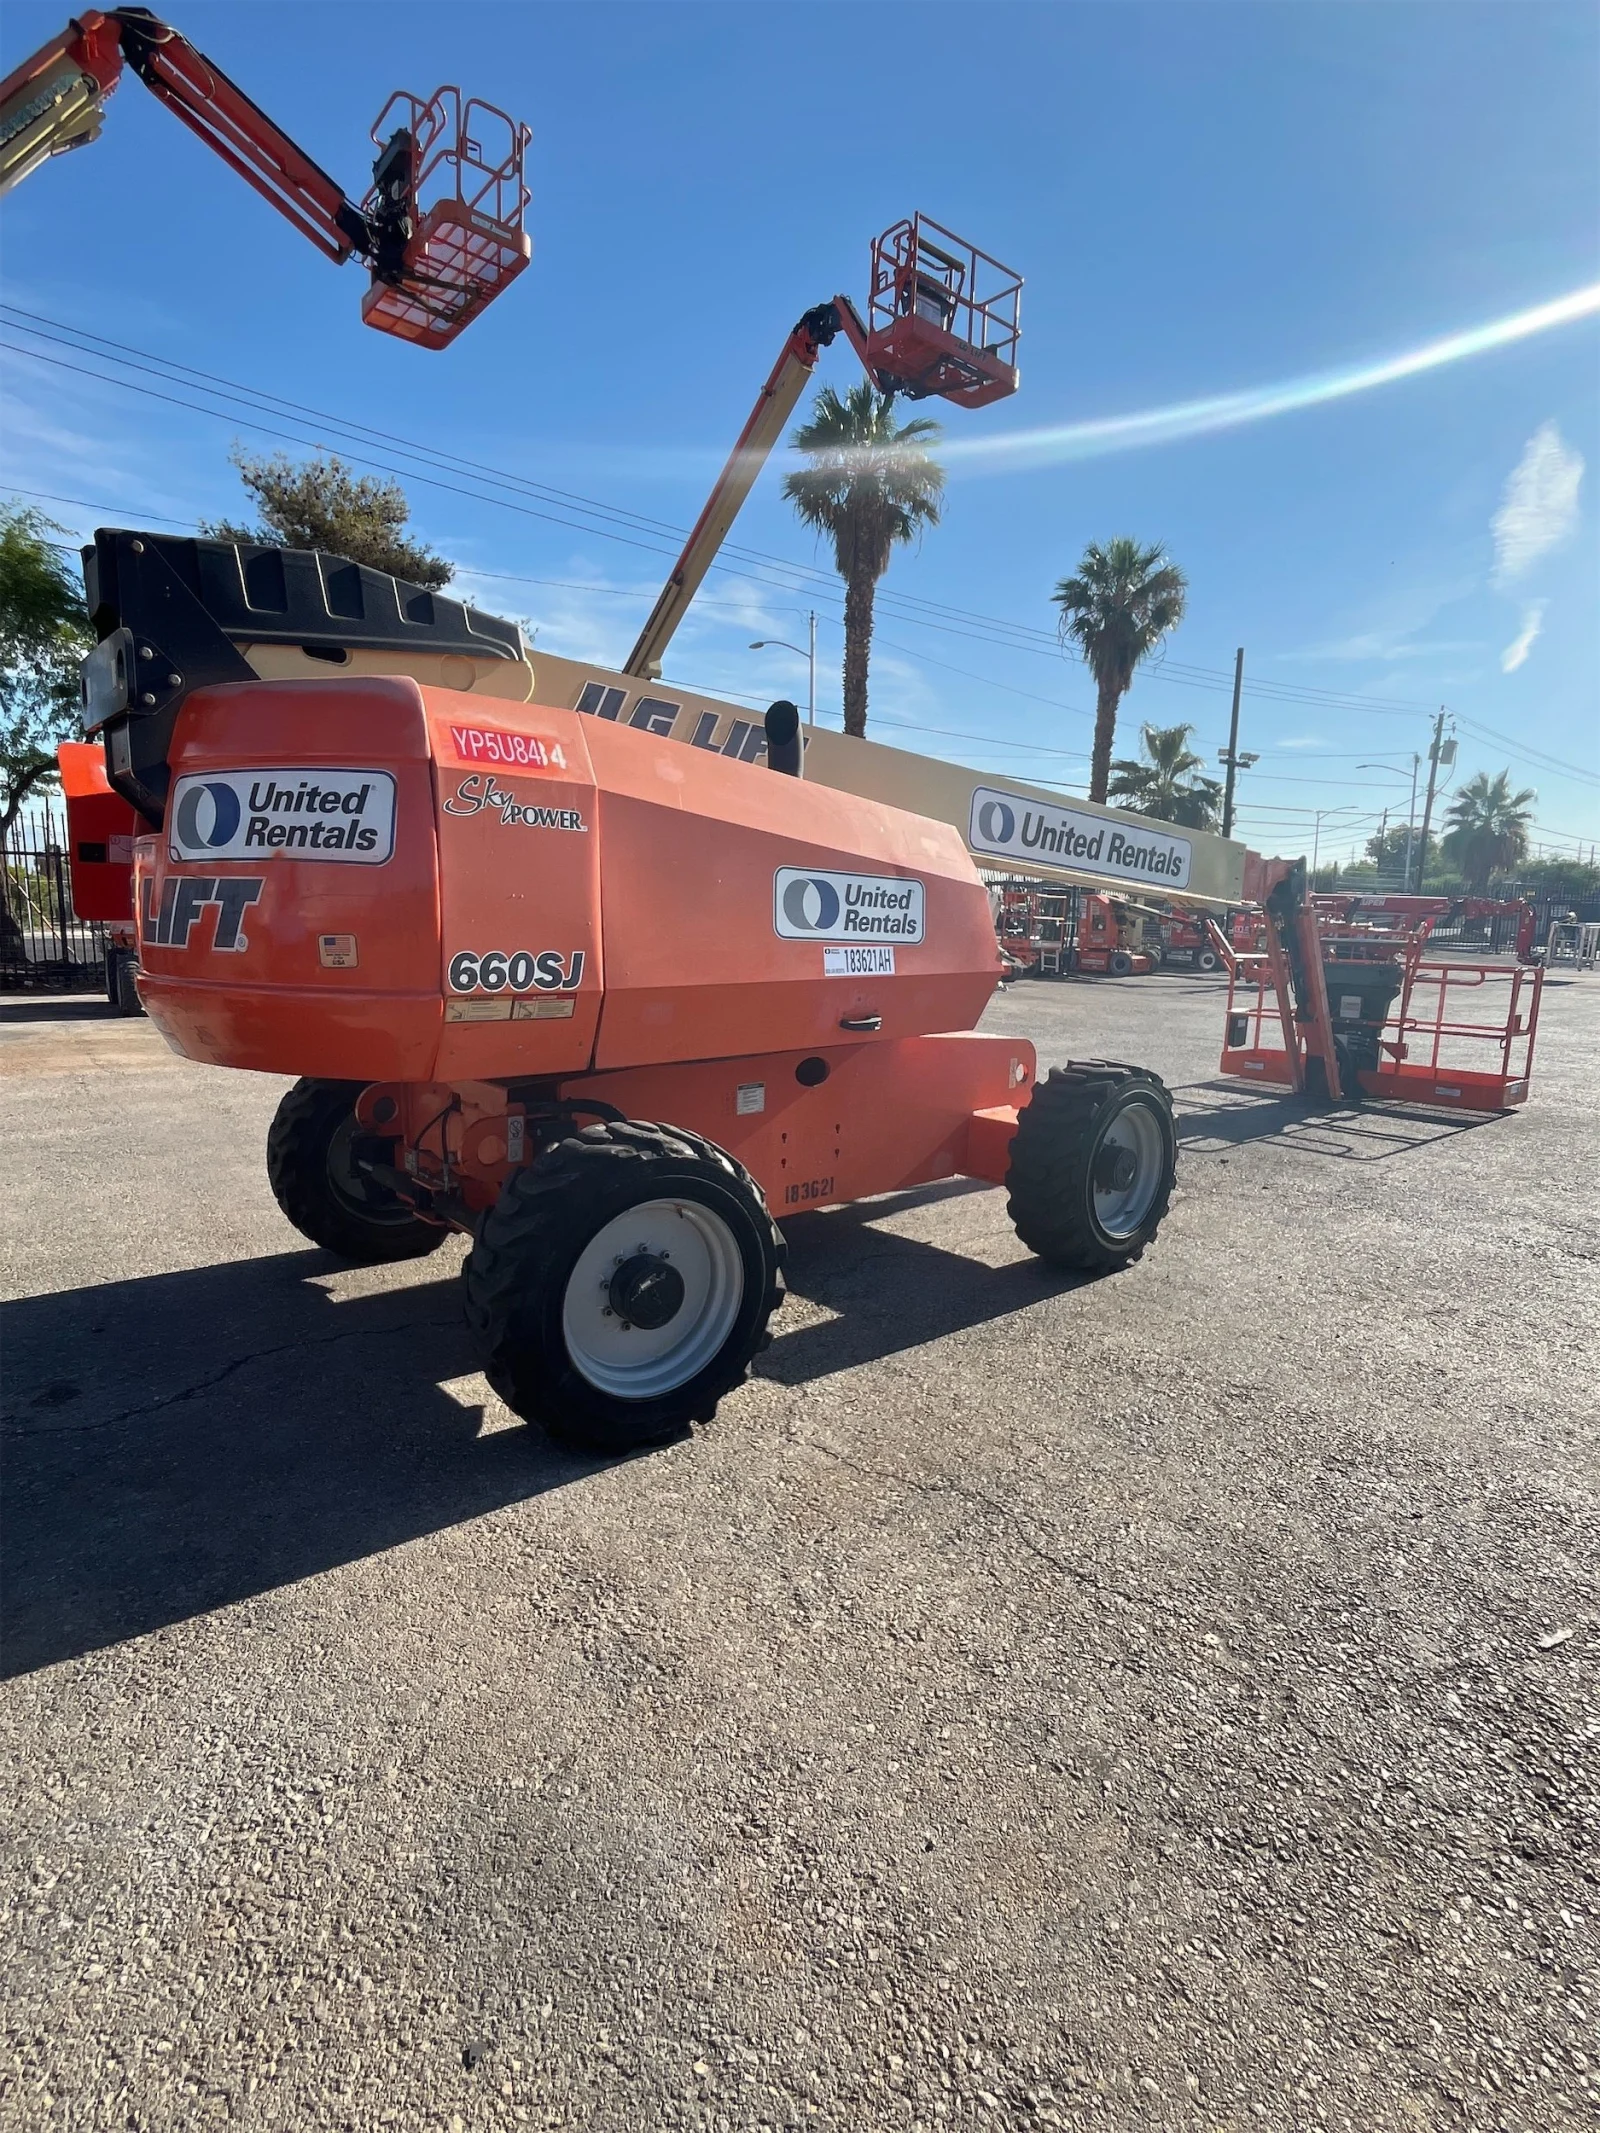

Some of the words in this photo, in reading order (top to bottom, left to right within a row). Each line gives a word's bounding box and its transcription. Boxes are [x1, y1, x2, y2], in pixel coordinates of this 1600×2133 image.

[690, 710, 812, 764] LIF
[249, 782, 370, 815] United
[245, 817, 378, 850] Rentals
[1021, 812, 1104, 861] United
[1107, 833, 1182, 877] Rentals
[845, 884, 912, 910] United
[142, 877, 267, 951] LIFT
[844, 909, 917, 934] Rentals
[448, 951, 586, 993] 660SJ
[844, 948, 892, 973] 183621AH
[784, 1176, 834, 1204] 183621
